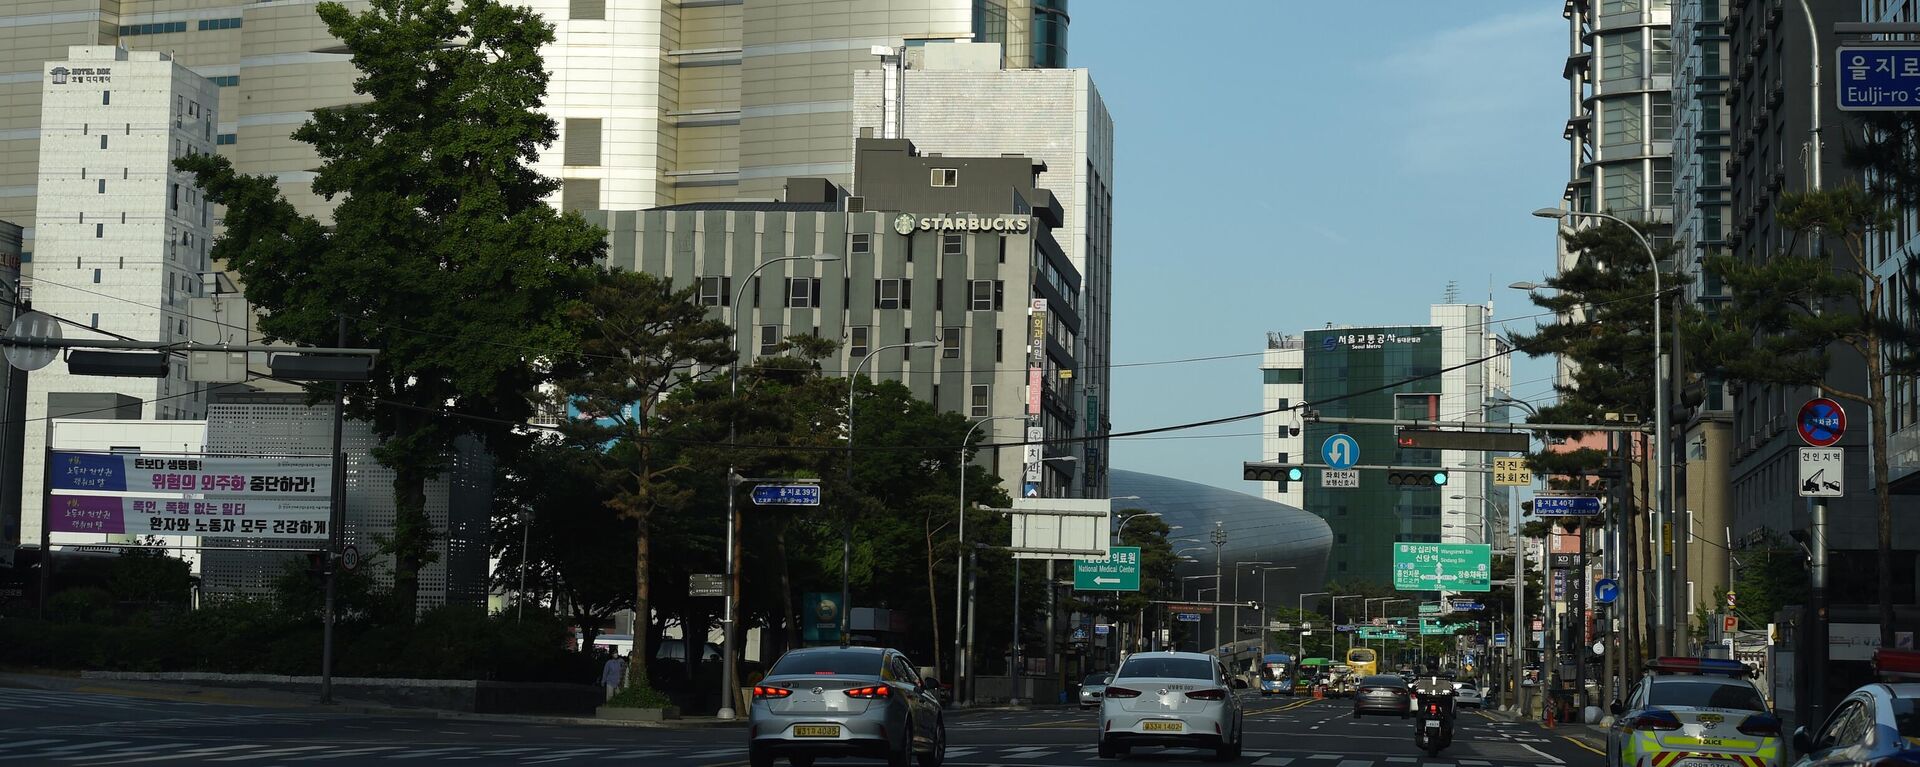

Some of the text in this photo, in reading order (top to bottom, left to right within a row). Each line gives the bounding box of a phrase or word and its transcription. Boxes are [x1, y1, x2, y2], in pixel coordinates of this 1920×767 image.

[1847, 55, 1920, 80] 을지로
[1847, 86, 1909, 105] Eulji-ro
[920, 217, 1028, 231] STARBUCKS
[1338, 333, 1396, 345] 서울교통공사
[135, 458, 203, 471] 돈보다 생명을!
[1326, 471, 1356, 479] 좌회전시
[1496, 472, 1529, 483] 좌회전
[152, 473, 316, 493] 위험의 외주화 중단하라!
[780, 487, 817, 497] 을지로39길
[133, 500, 246, 516] 폭언, 폭행 없는 일터
[1536, 499, 1574, 508] 을지로40길
[150, 516, 190, 531] 환자와
[195, 518, 235, 533] 노동자
[241, 519, 267, 534] 모두
[345, 553, 356, 565] 30
[1416, 554, 1439, 563] 신당역
[1079, 564, 1136, 574] National Medical Center
[1725, 617, 1736, 632] P
